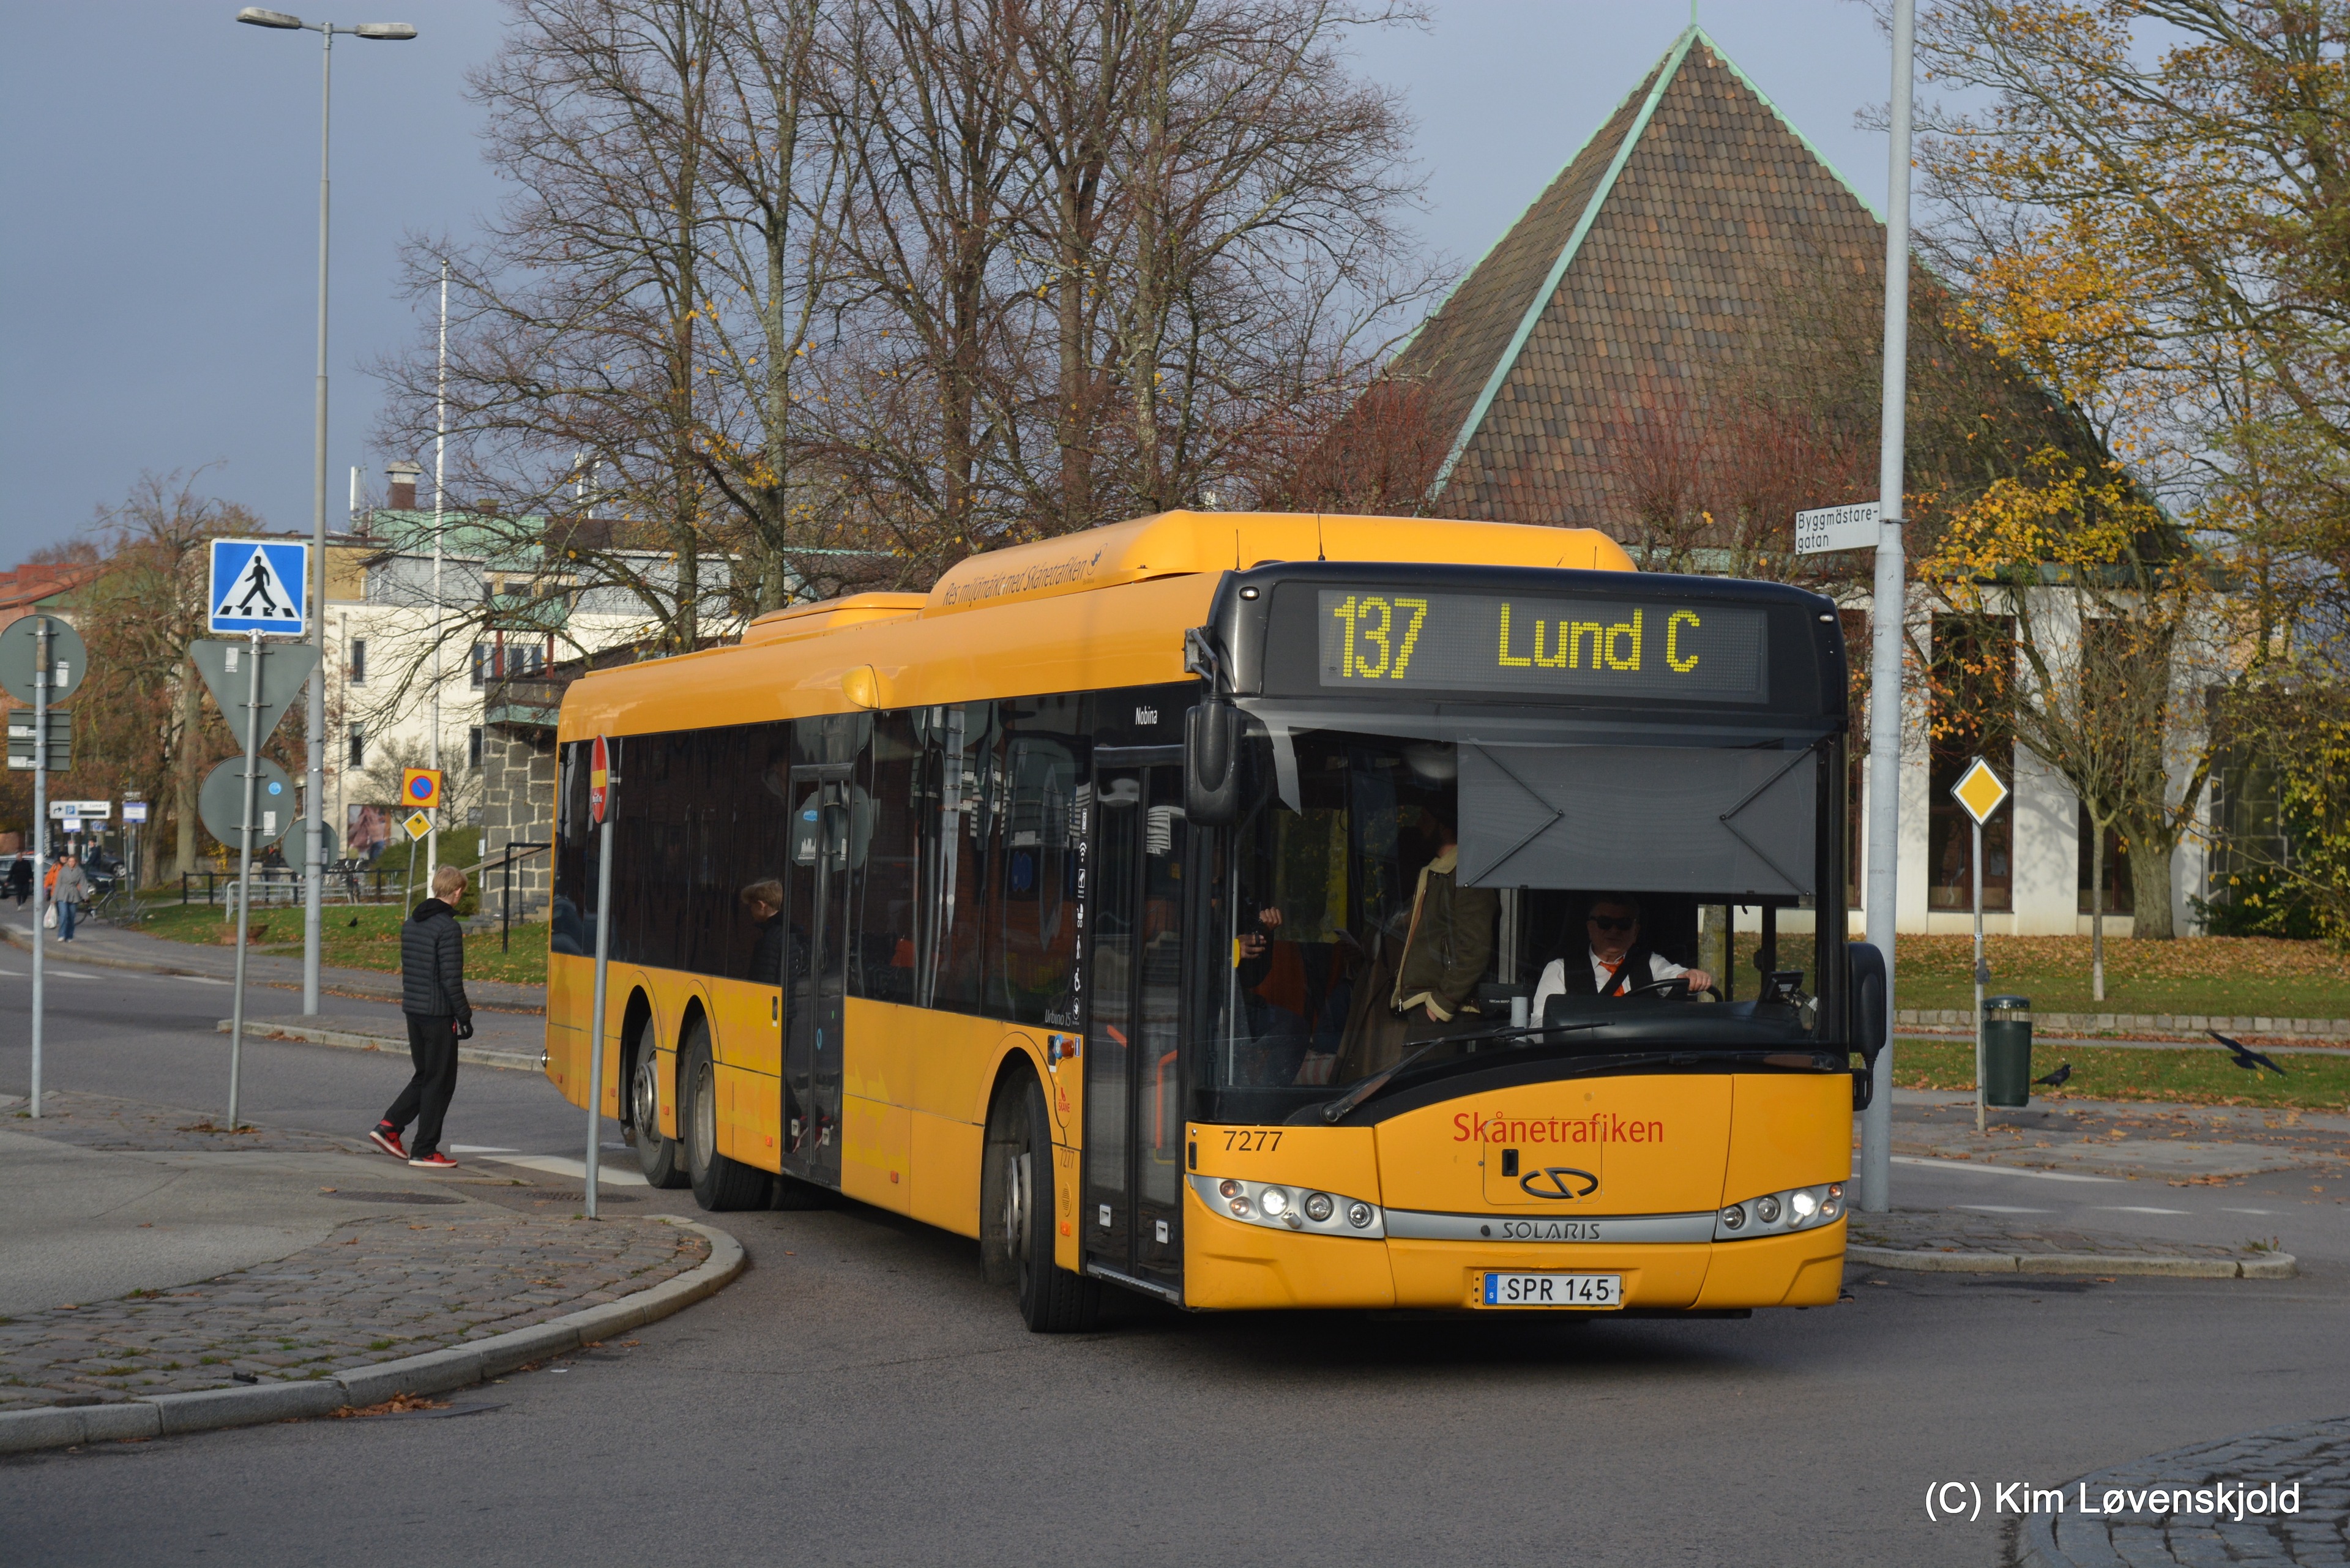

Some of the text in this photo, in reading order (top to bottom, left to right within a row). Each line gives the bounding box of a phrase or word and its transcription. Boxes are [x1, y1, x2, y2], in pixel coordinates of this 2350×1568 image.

[1798, 507, 1878, 532] Byggmästare-
[1797, 532, 1829, 554] gatan
[942, 555, 1087, 607] Res miljömärkt med Skånetrafiken
[1334, 595, 1427, 679] 137
[1499, 602, 1700, 673] Lund C
[1135, 705, 1158, 725] Nobina
[1045, 1009, 1072, 1027] Urbino 15
[1453, 1111, 1663, 1143] Skånetrafiken
[1223, 1130, 1283, 1152] 7277
[1060, 1148, 1075, 1169] 7277
[1502, 1222, 1600, 1239] SOLARIS
[1507, 1278, 1553, 1301] SPR
[1565, 1279, 1609, 1301] 145
